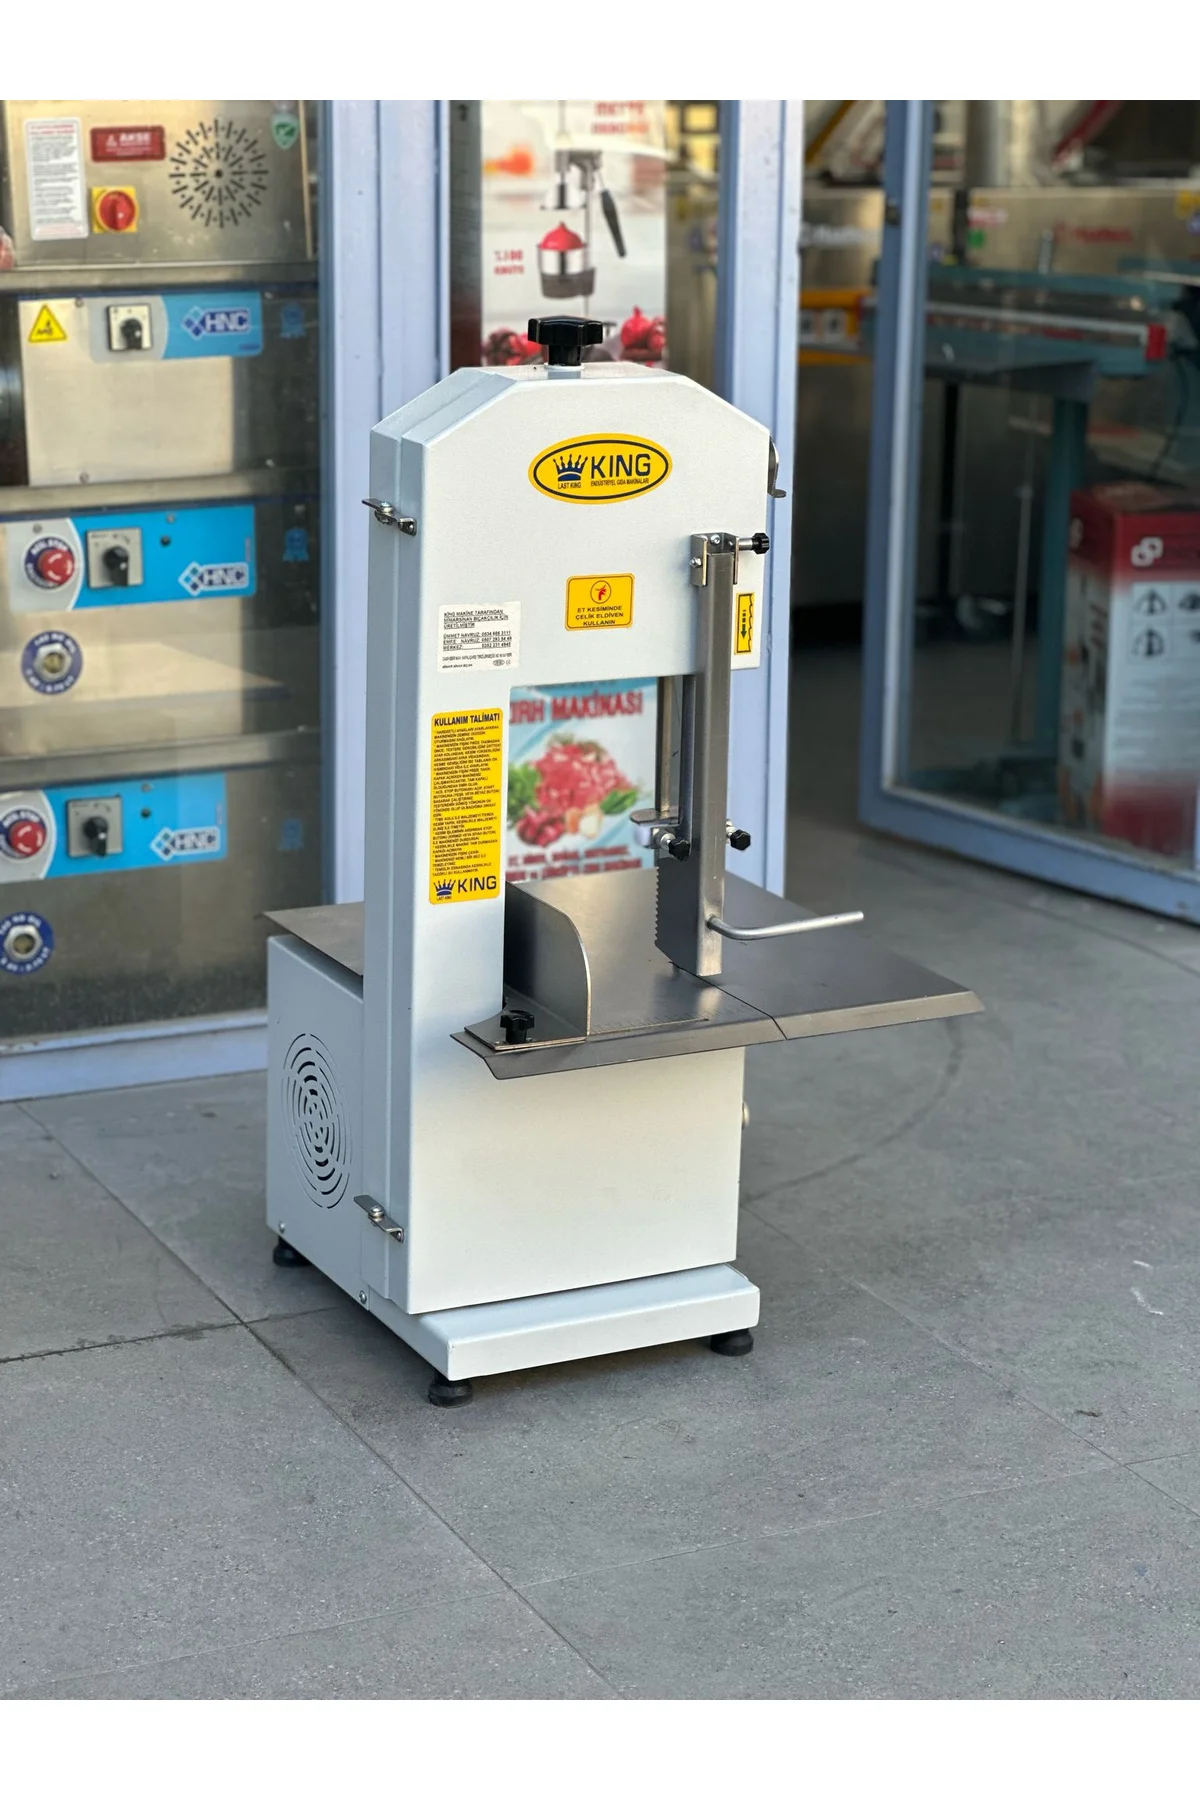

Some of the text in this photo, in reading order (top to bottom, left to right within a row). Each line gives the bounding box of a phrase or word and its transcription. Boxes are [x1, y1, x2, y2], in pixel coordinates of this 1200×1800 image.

[206, 310, 248, 332] HNC
[590, 453, 651, 479] KING
[202, 565, 246, 587] HNC
[552, 690, 643, 720] MAKİNASI
[434, 712, 500, 726] KULLANIM TALİMATI
[172, 830, 218, 850] HNC
[458, 876, 497, 893] KING
